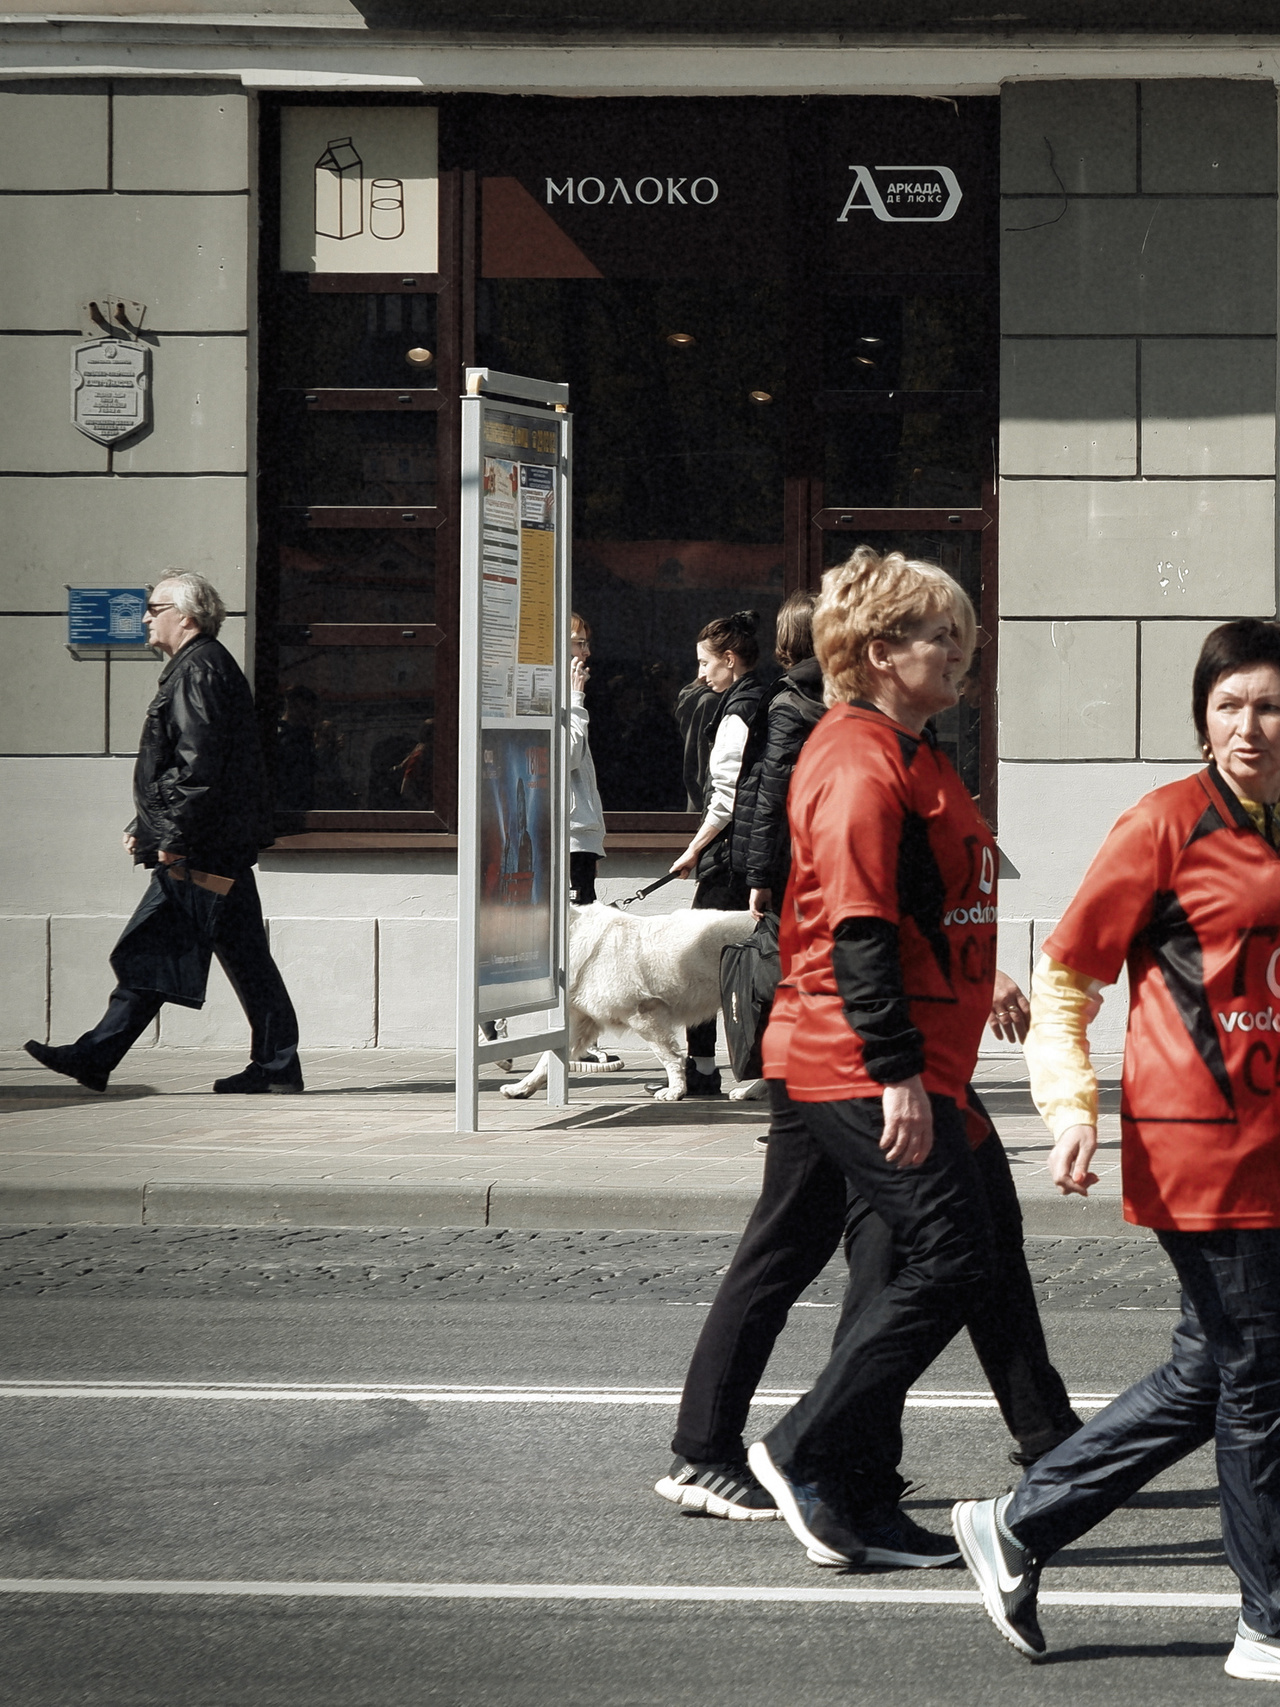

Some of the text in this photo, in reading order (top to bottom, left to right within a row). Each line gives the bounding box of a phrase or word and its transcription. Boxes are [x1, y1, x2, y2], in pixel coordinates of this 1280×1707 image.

[545, 176, 719, 205] МОЛОКО
[886, 182, 942, 195] АРКАДА
[886, 194, 942, 204] ДЕ ЛЮКС
